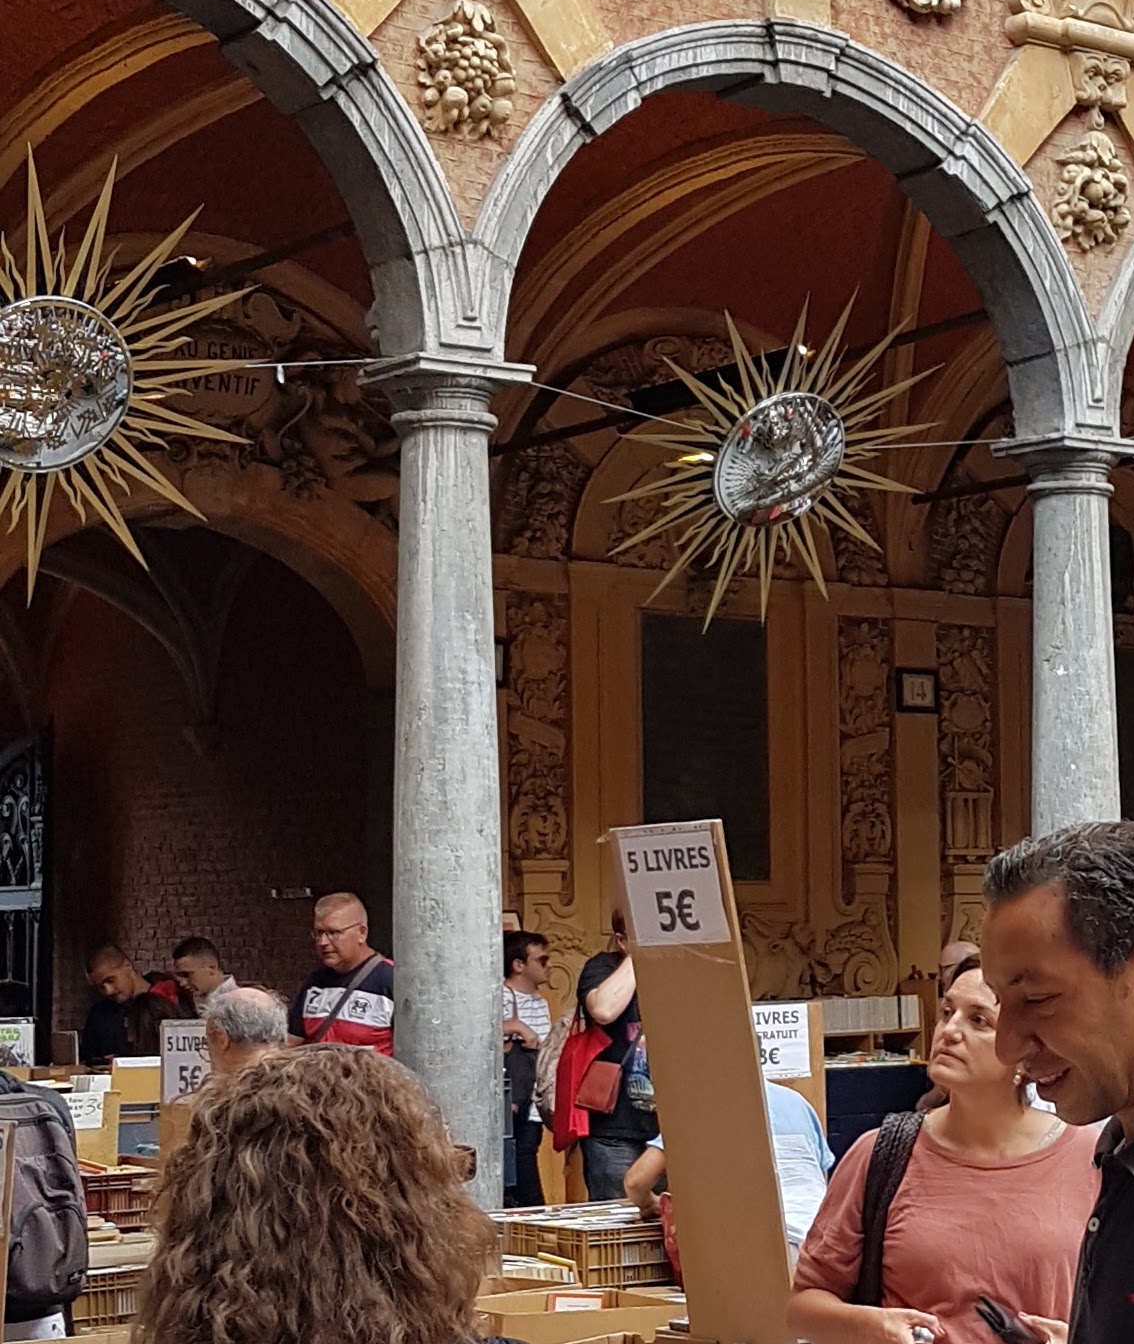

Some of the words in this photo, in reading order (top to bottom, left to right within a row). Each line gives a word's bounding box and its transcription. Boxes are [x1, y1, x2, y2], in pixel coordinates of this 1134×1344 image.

[174, 373, 261, 396] NVENTIF
[627, 851, 639, 873] 5
[643, 845, 711, 872] LIVRES
[655, 889, 701, 932] 5€
[755, 1010, 800, 1025] IVRES
[167, 1036, 174, 1052] 5
[178, 1065, 203, 1094] 5€
